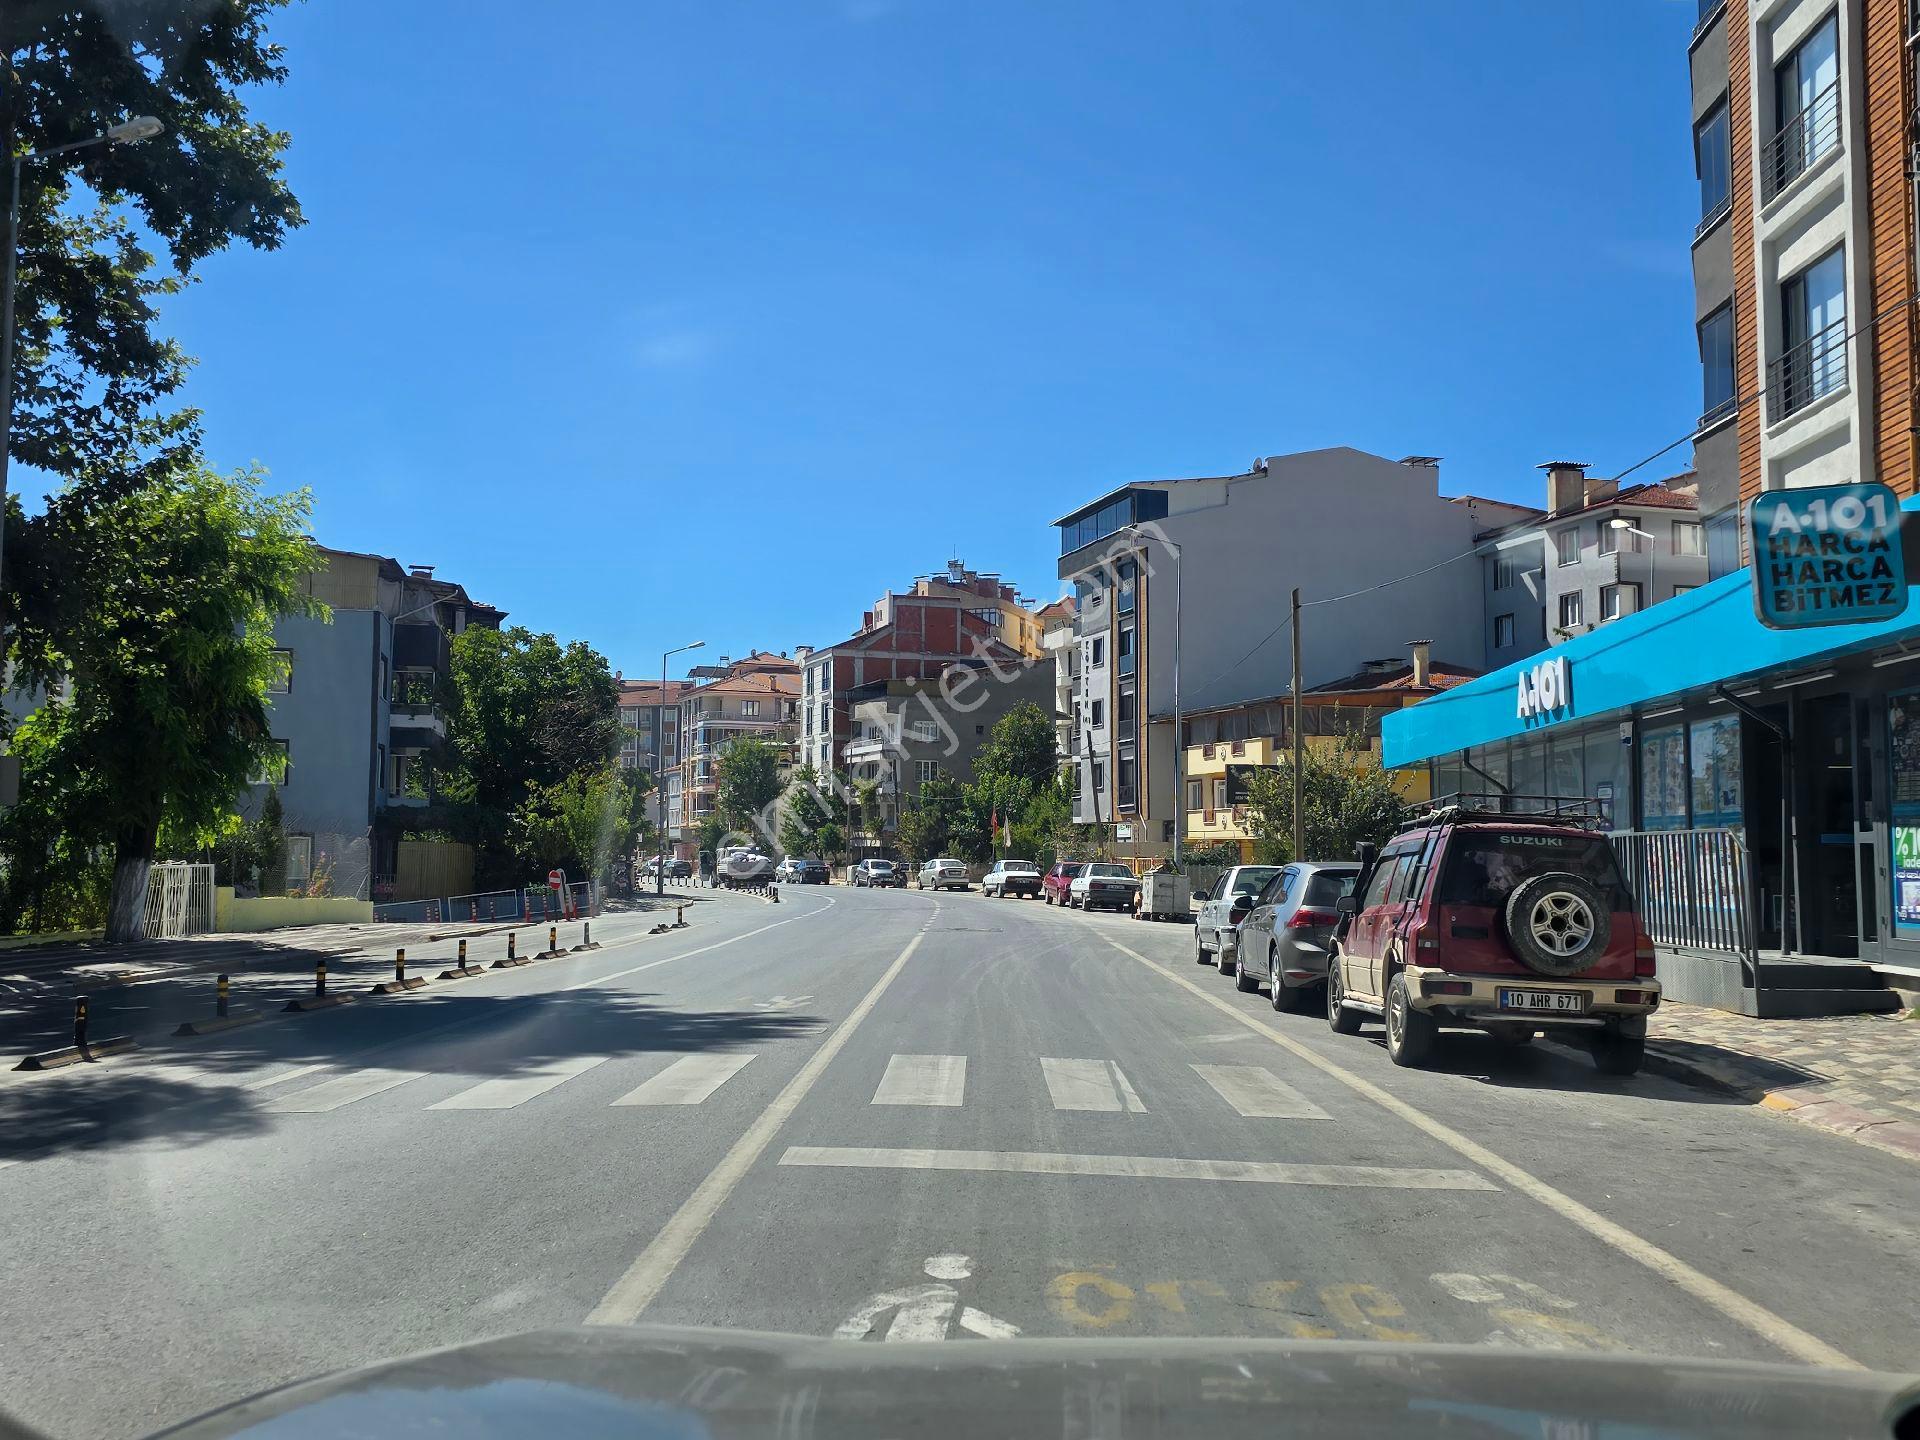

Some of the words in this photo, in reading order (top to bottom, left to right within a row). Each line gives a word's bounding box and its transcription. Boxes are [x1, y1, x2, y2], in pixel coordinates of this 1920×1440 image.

[1768, 527, 1890, 560] HARCA
[1771, 556, 1894, 586] HARCA
[1500, 835, 1562, 847] SUZUKI
[1510, 993, 1523, 1007] 10
[1530, 994, 1551, 1008] AHR
[1558, 995, 1579, 1009] 671
